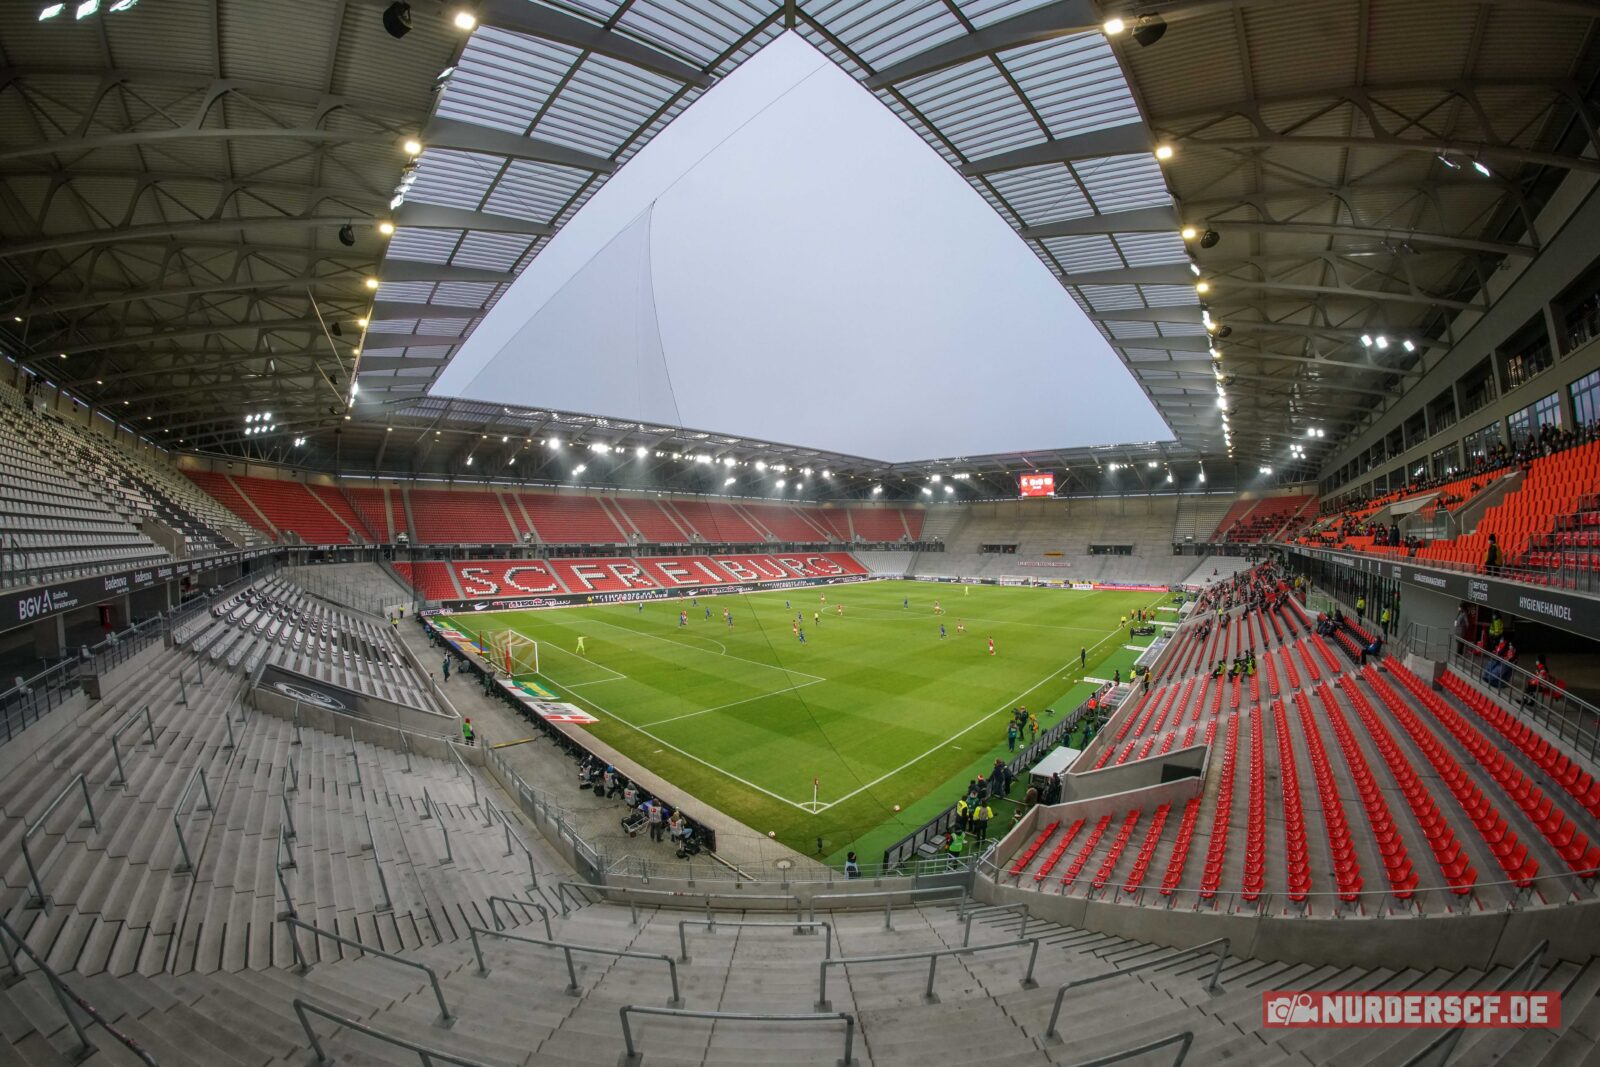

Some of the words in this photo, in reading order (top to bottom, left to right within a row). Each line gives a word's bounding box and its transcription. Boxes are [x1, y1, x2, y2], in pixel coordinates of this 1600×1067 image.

[104, 575, 127, 591] badenova
[570, 556, 843, 590] FREIBURG
[1519, 597, 1572, 621] HYGIENEHANDEL
